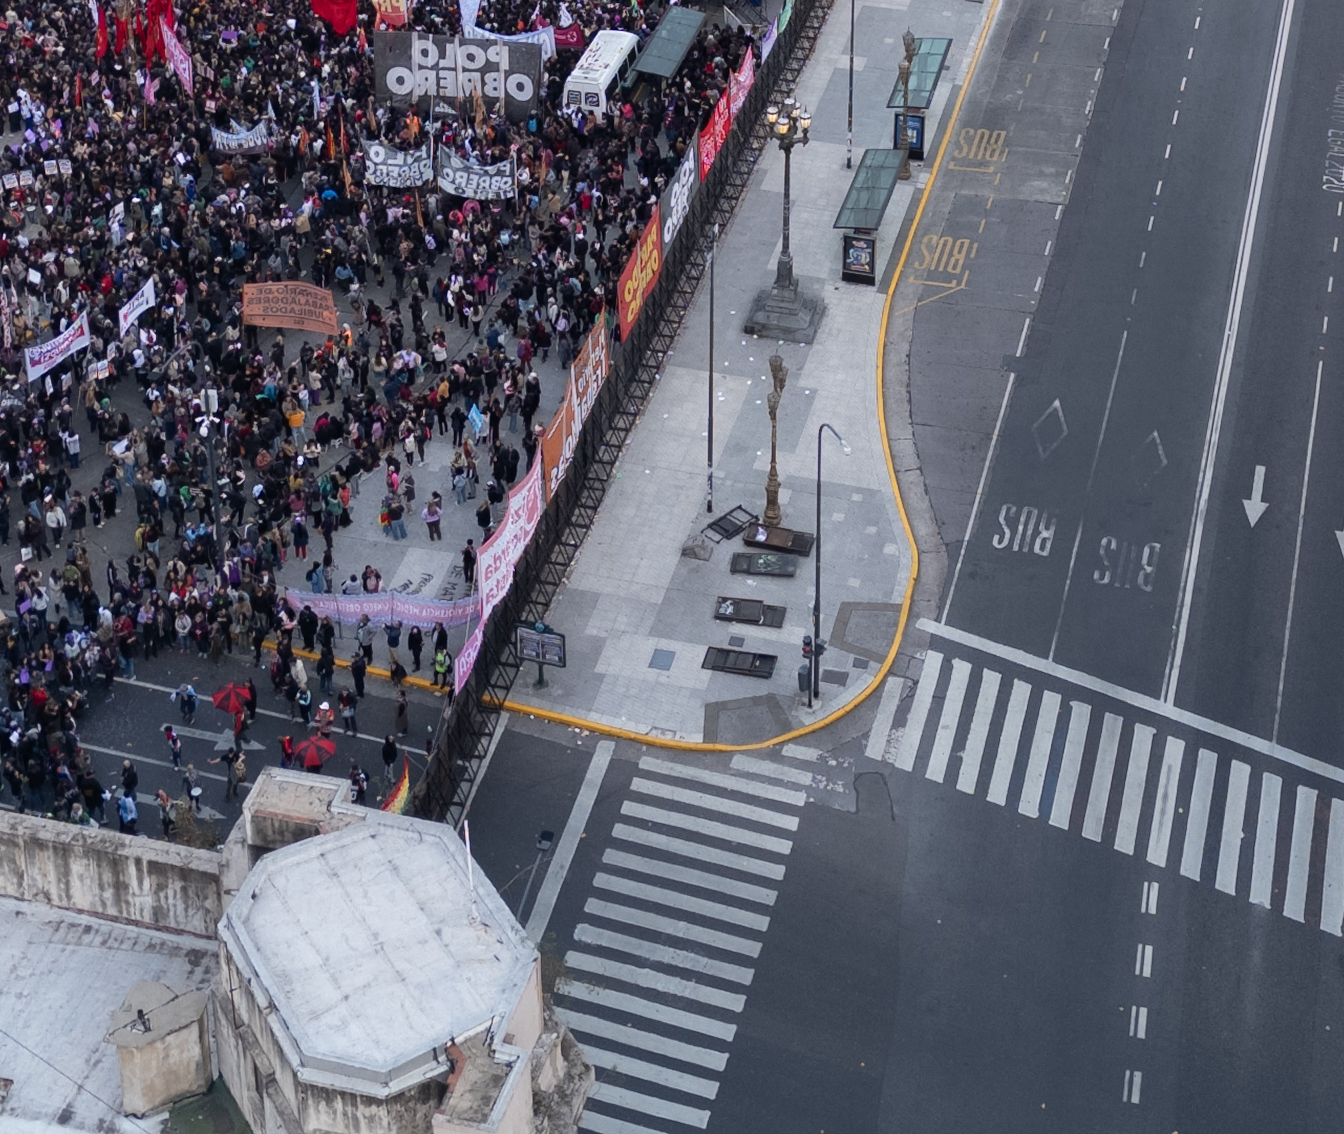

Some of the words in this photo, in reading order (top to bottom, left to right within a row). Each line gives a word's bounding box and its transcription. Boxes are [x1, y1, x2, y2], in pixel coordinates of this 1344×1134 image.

[955, 128, 1007, 161] BUS
[914, 235, 970, 274] BUS
[992, 504, 1056, 557] BUS
[1094, 536, 1162, 592] BUS
